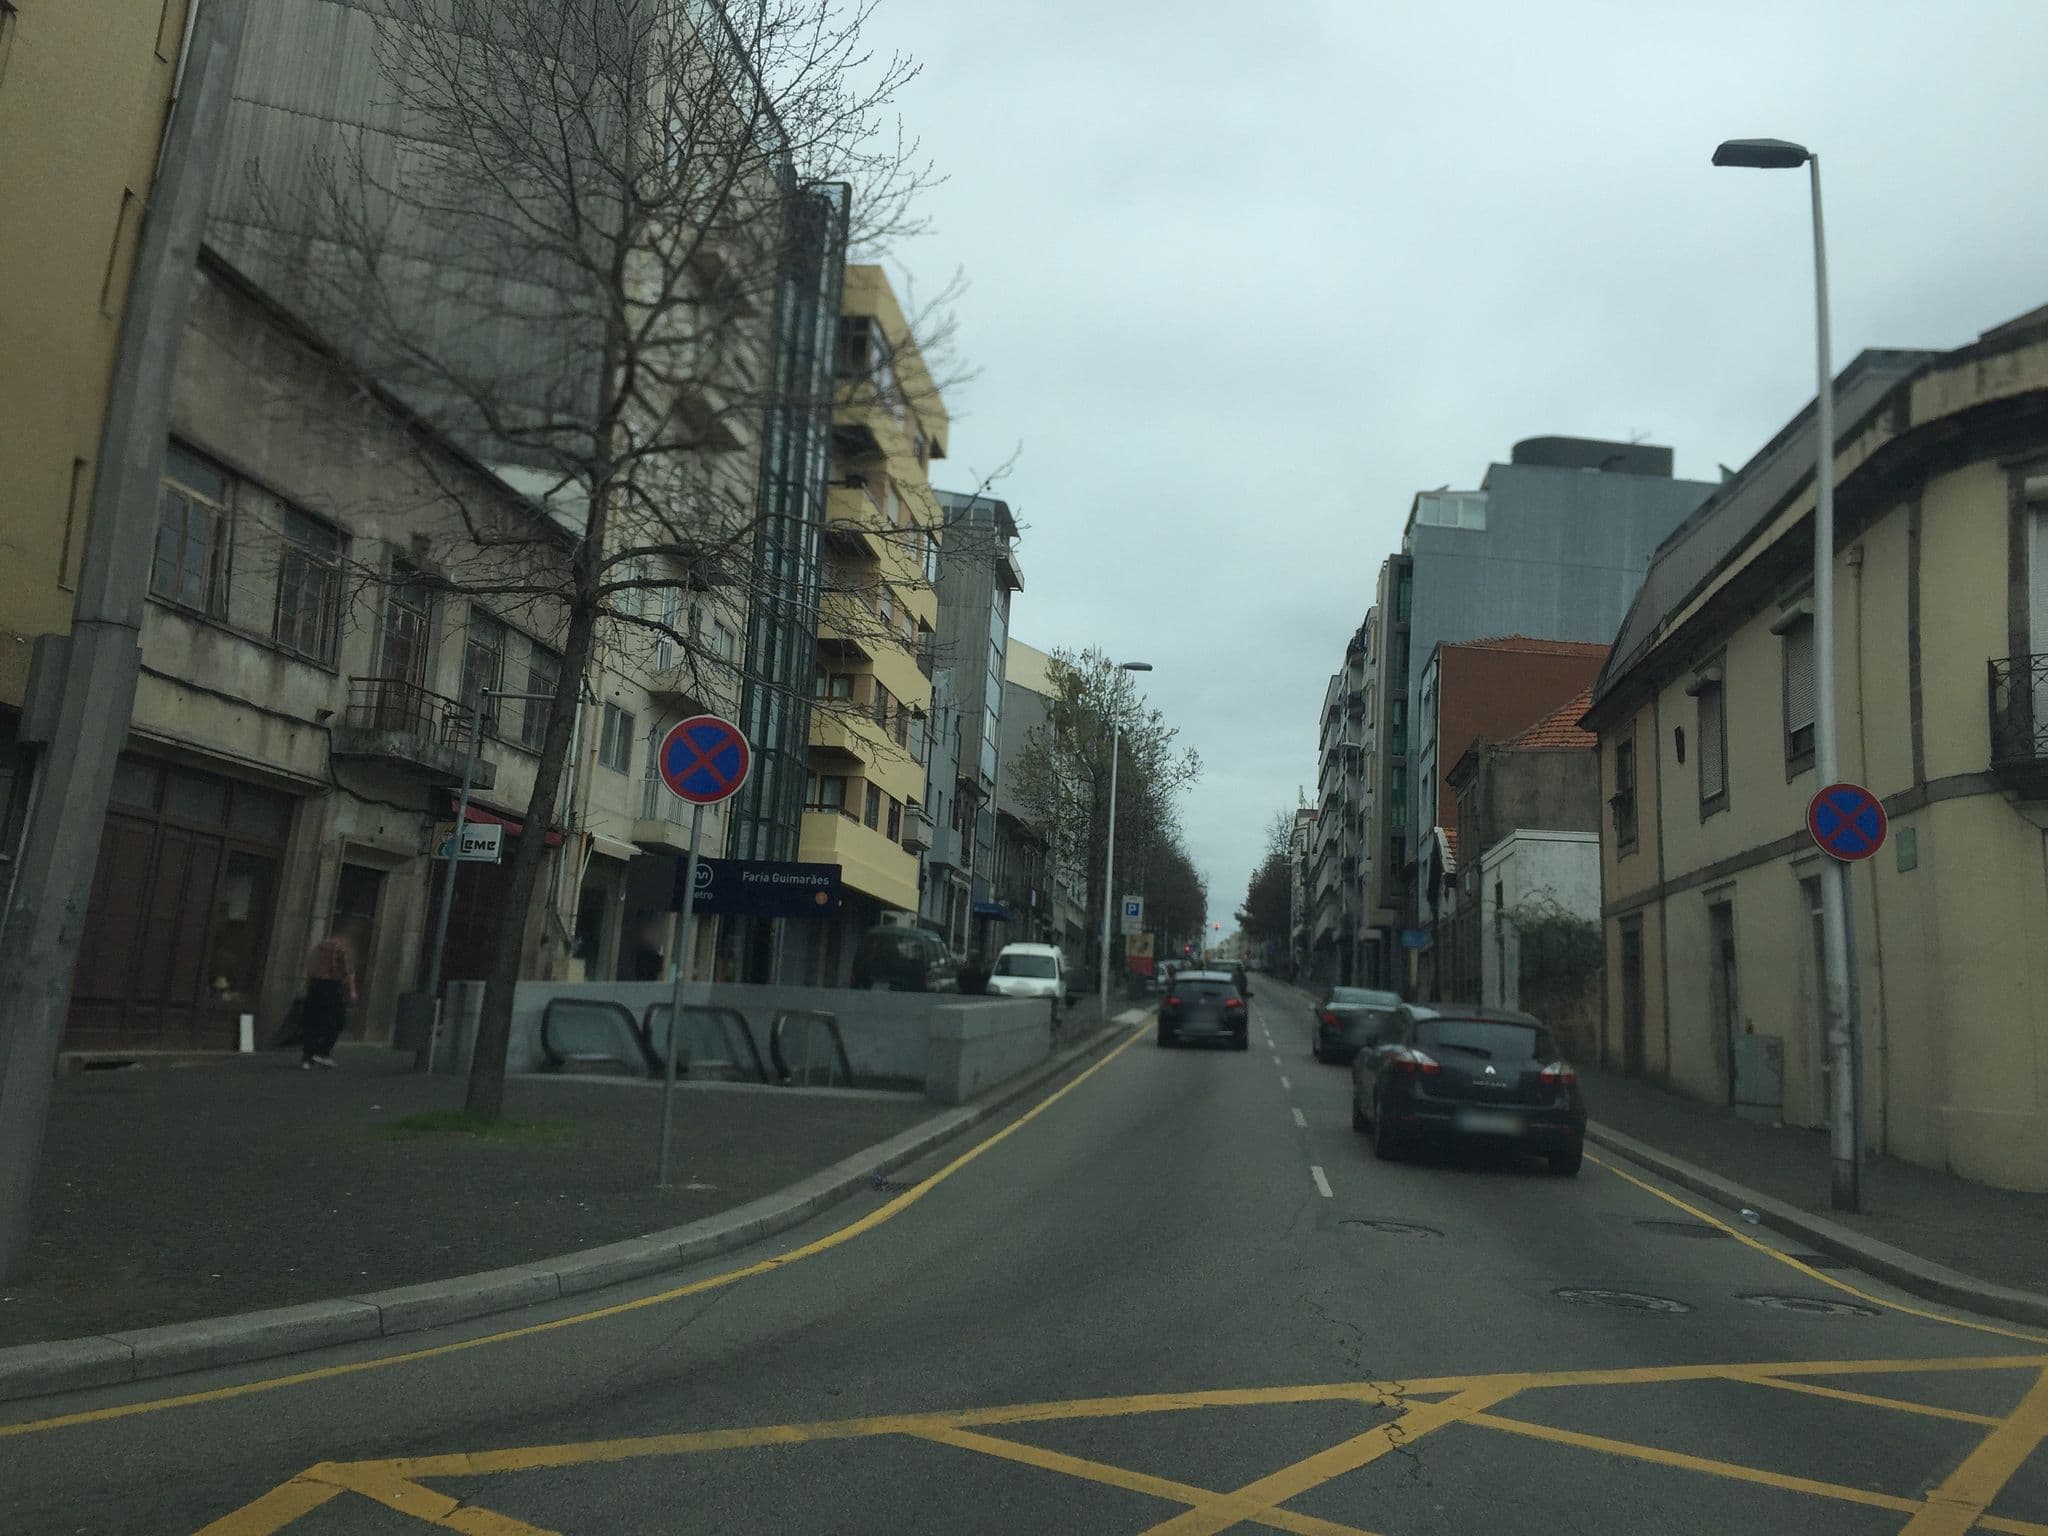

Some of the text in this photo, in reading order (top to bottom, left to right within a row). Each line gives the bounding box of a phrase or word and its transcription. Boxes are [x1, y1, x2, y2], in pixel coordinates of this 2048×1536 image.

[742, 871, 830, 886] Faria Guimarães
[694, 890, 713, 900] etro
